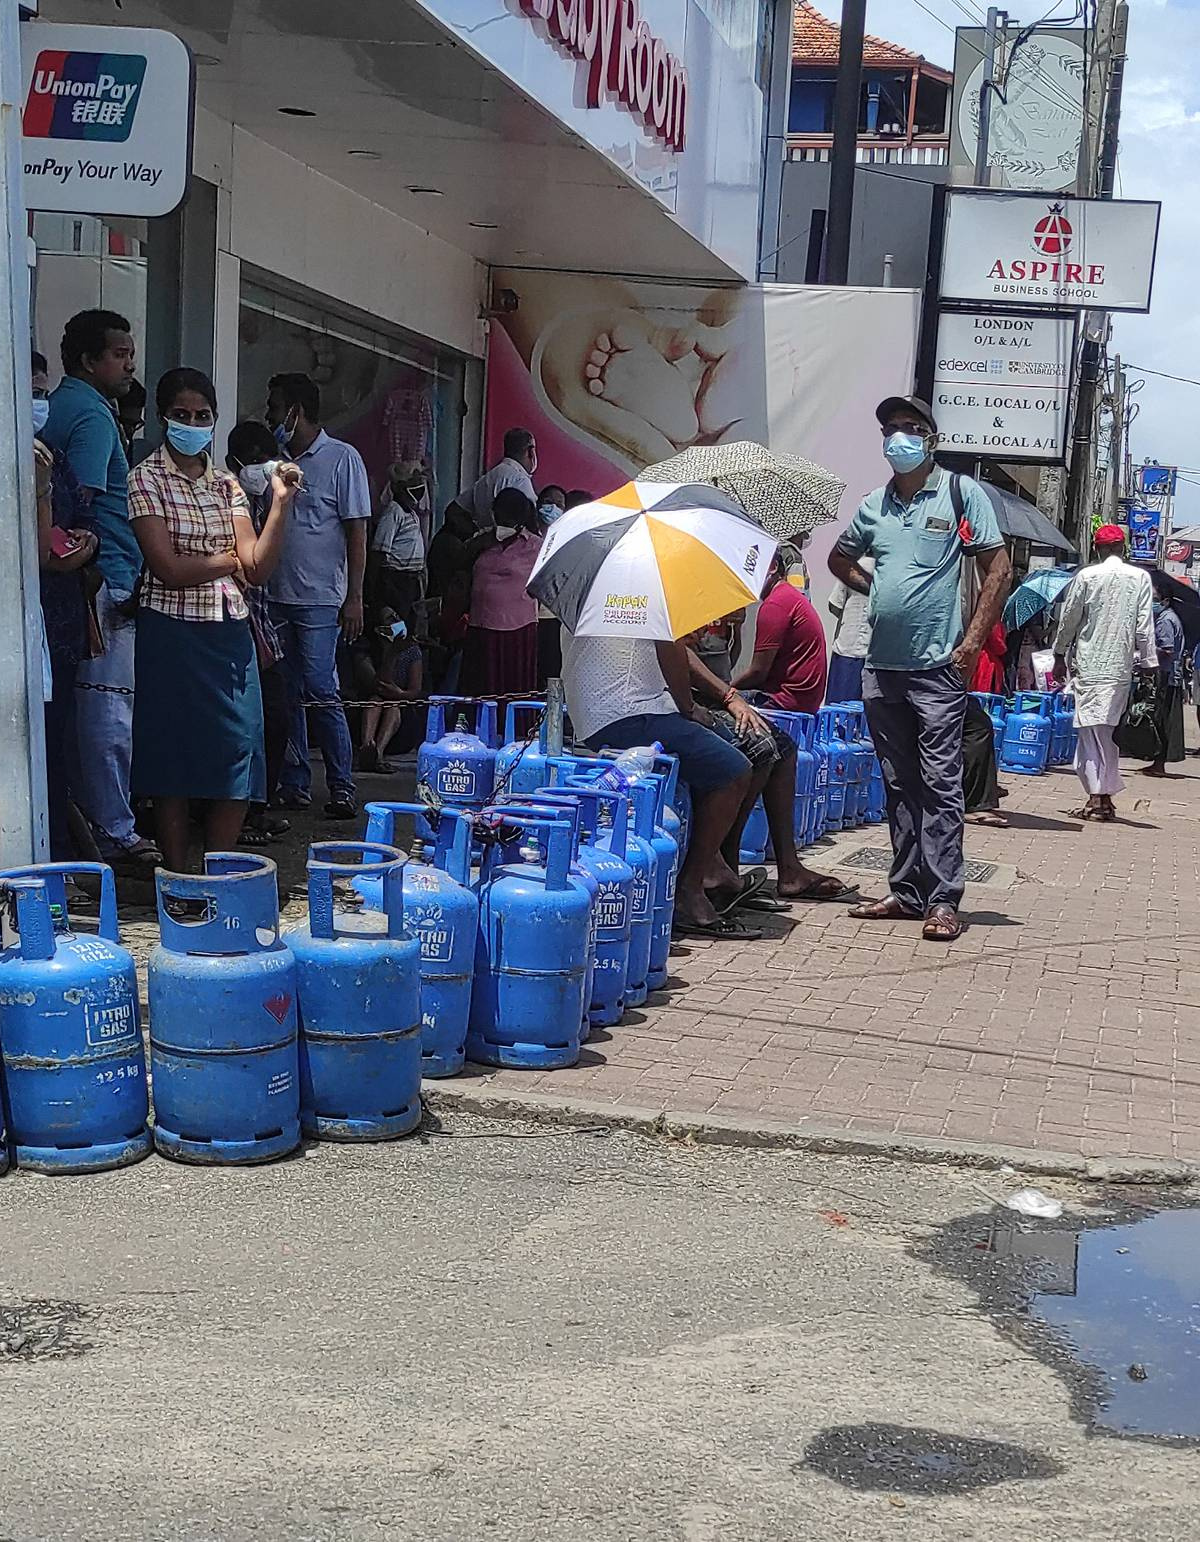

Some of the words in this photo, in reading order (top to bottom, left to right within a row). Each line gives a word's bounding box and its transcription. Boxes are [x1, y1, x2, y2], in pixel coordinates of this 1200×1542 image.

[34, 70, 138, 107] UnionPay
[72, 100, 126, 125] 银联
[24, 158, 73, 184] onPay
[77, 159, 118, 179] Your
[123, 162, 162, 187] Way
[986, 259, 1105, 285] ASPIRE
[993, 284, 1048, 296] BUSINESS
[1052, 287, 1099, 299] SCHOOL
[974, 318, 1034, 331] LONDON
[974, 335, 995, 347] O/L
[998, 337, 1007, 346] &
[1010, 337, 1032, 349] A/L
[938, 358, 988, 373] edexcel
[938, 394, 979, 407] G.C.E.
[984, 397, 1031, 410] LOCAL
[1035, 399, 1061, 413] O/L
[992, 416, 1004, 428] &
[982, 435, 1030, 448] LOCAL
[1033, 437, 1058, 451] A/L
[442, 774, 470, 785] LITRO
[445, 783, 466, 793] GAS
[597, 902, 622, 914] ITRO
[418, 931, 447, 944] TRO
[420, 944, 440, 957] AS
[593, 959, 609, 969] 2.5
[100, 1019, 128, 1038] GAS
